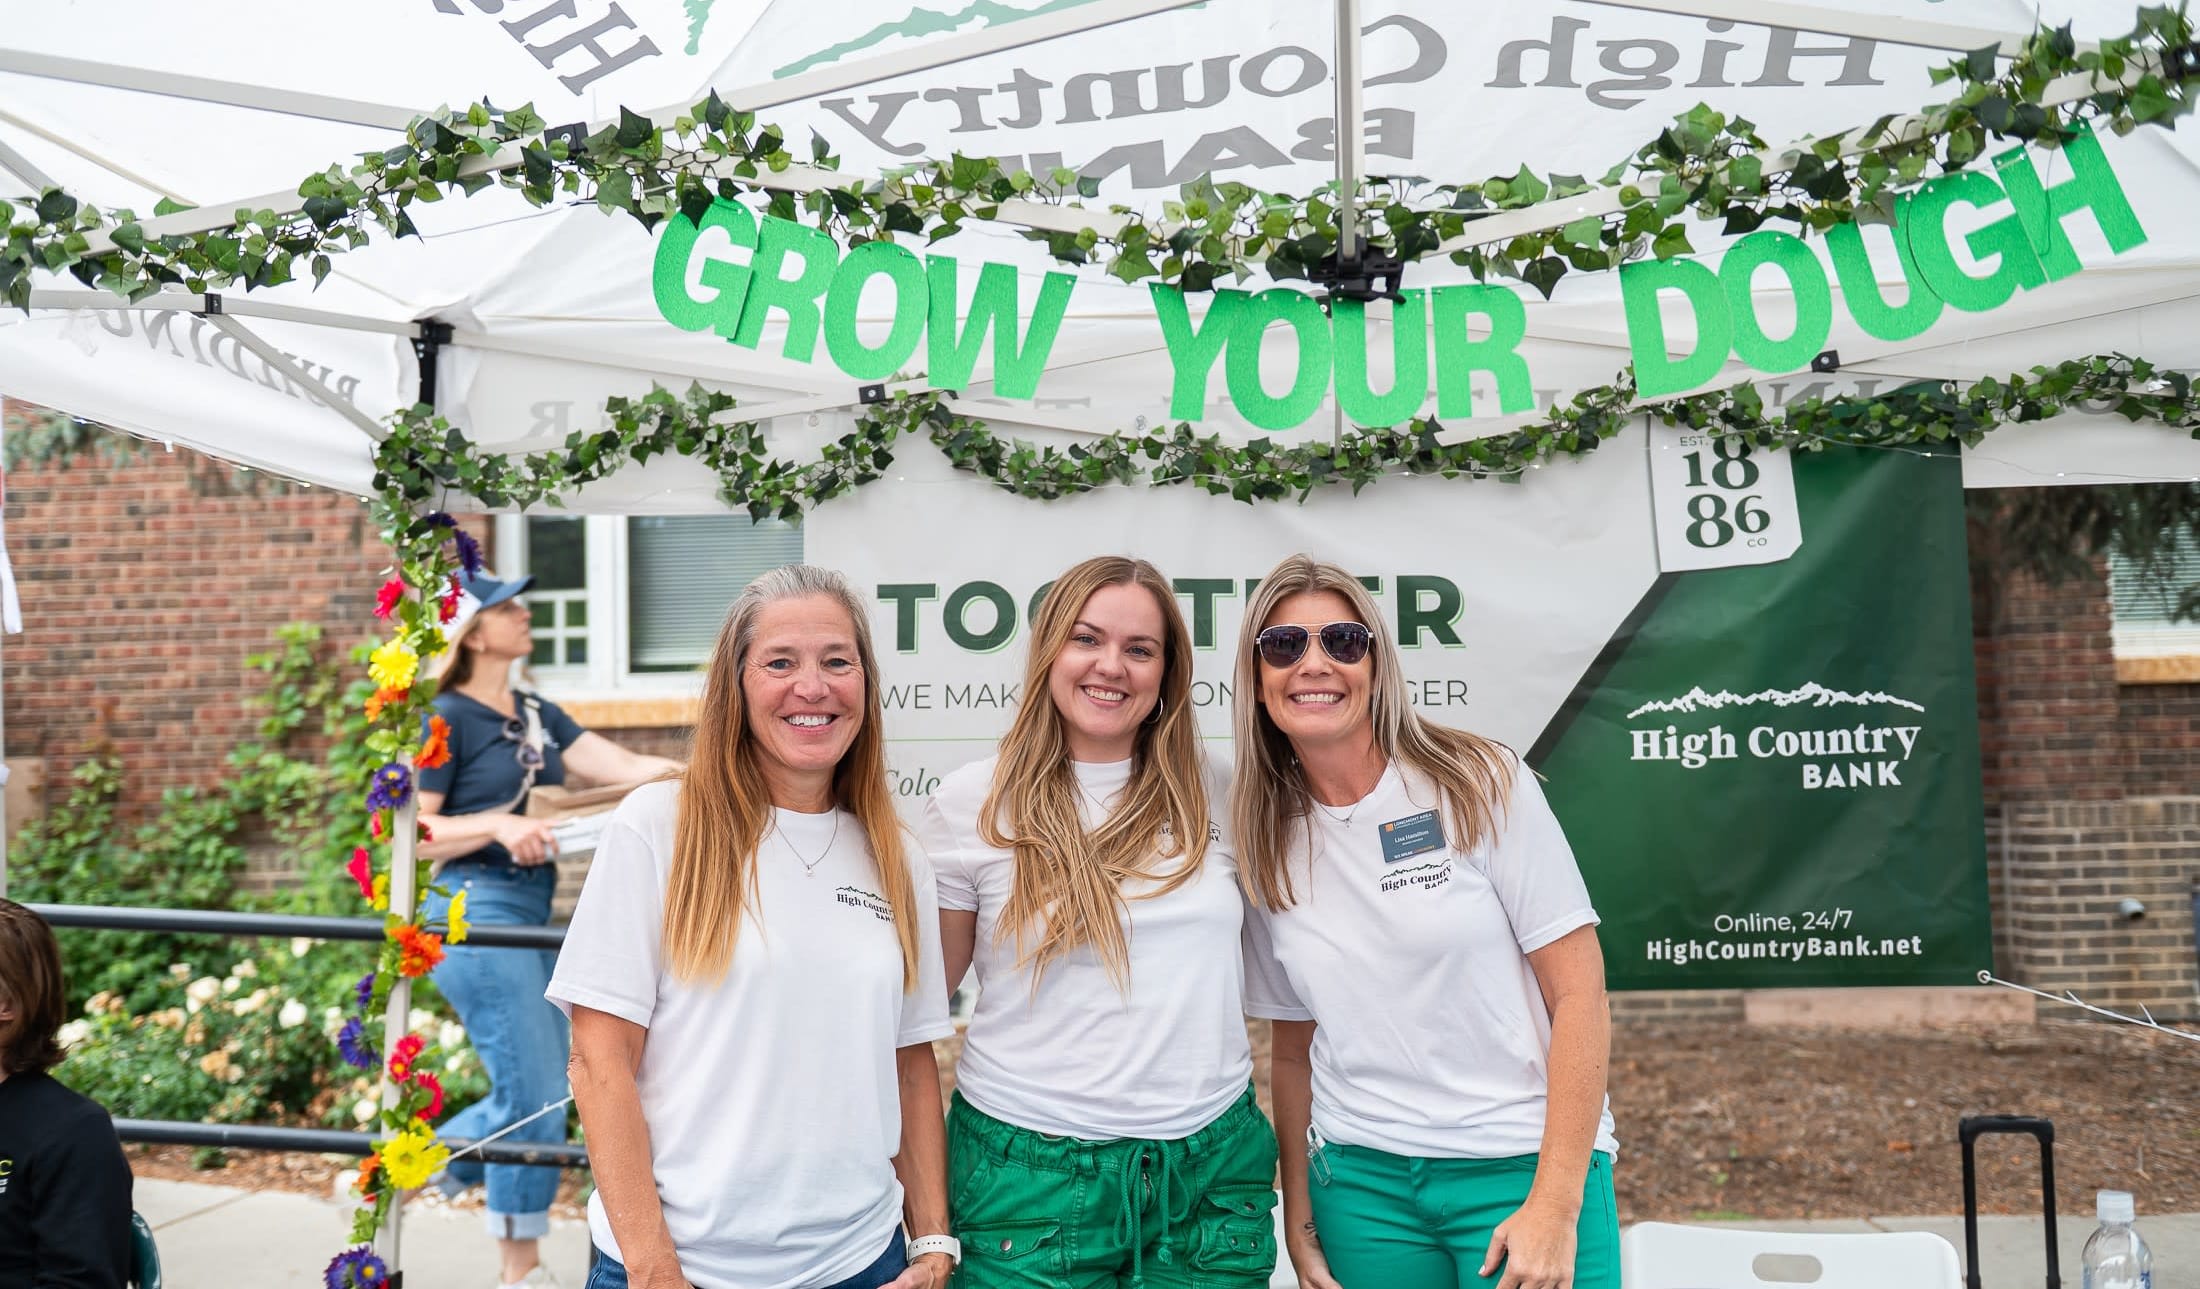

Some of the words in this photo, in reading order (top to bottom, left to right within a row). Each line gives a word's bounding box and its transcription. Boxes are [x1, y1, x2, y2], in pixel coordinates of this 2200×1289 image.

[653, 195, 1078, 400] GROW
[1148, 282, 1535, 430] YOUR
[1619, 117, 2148, 398] DOUGH
[1680, 436, 1709, 447] EST.
[1682, 433, 1760, 490] 18
[1686, 493, 1771, 548] 86
[1747, 537, 1768, 548] CO
[881, 684, 932, 709] WE
[945, 683, 1020, 709] MAK
[1630, 725, 1738, 769] High
[1748, 723, 1922, 760] Country
[1802, 760, 1902, 789] BANK
[1381, 878, 1407, 892] High
[837, 894, 861, 906] High
[1714, 912, 1797, 934] Online,
[1802, 907, 1853, 931] 24/7
[1647, 935, 1922, 965] HighCountryBank.net
